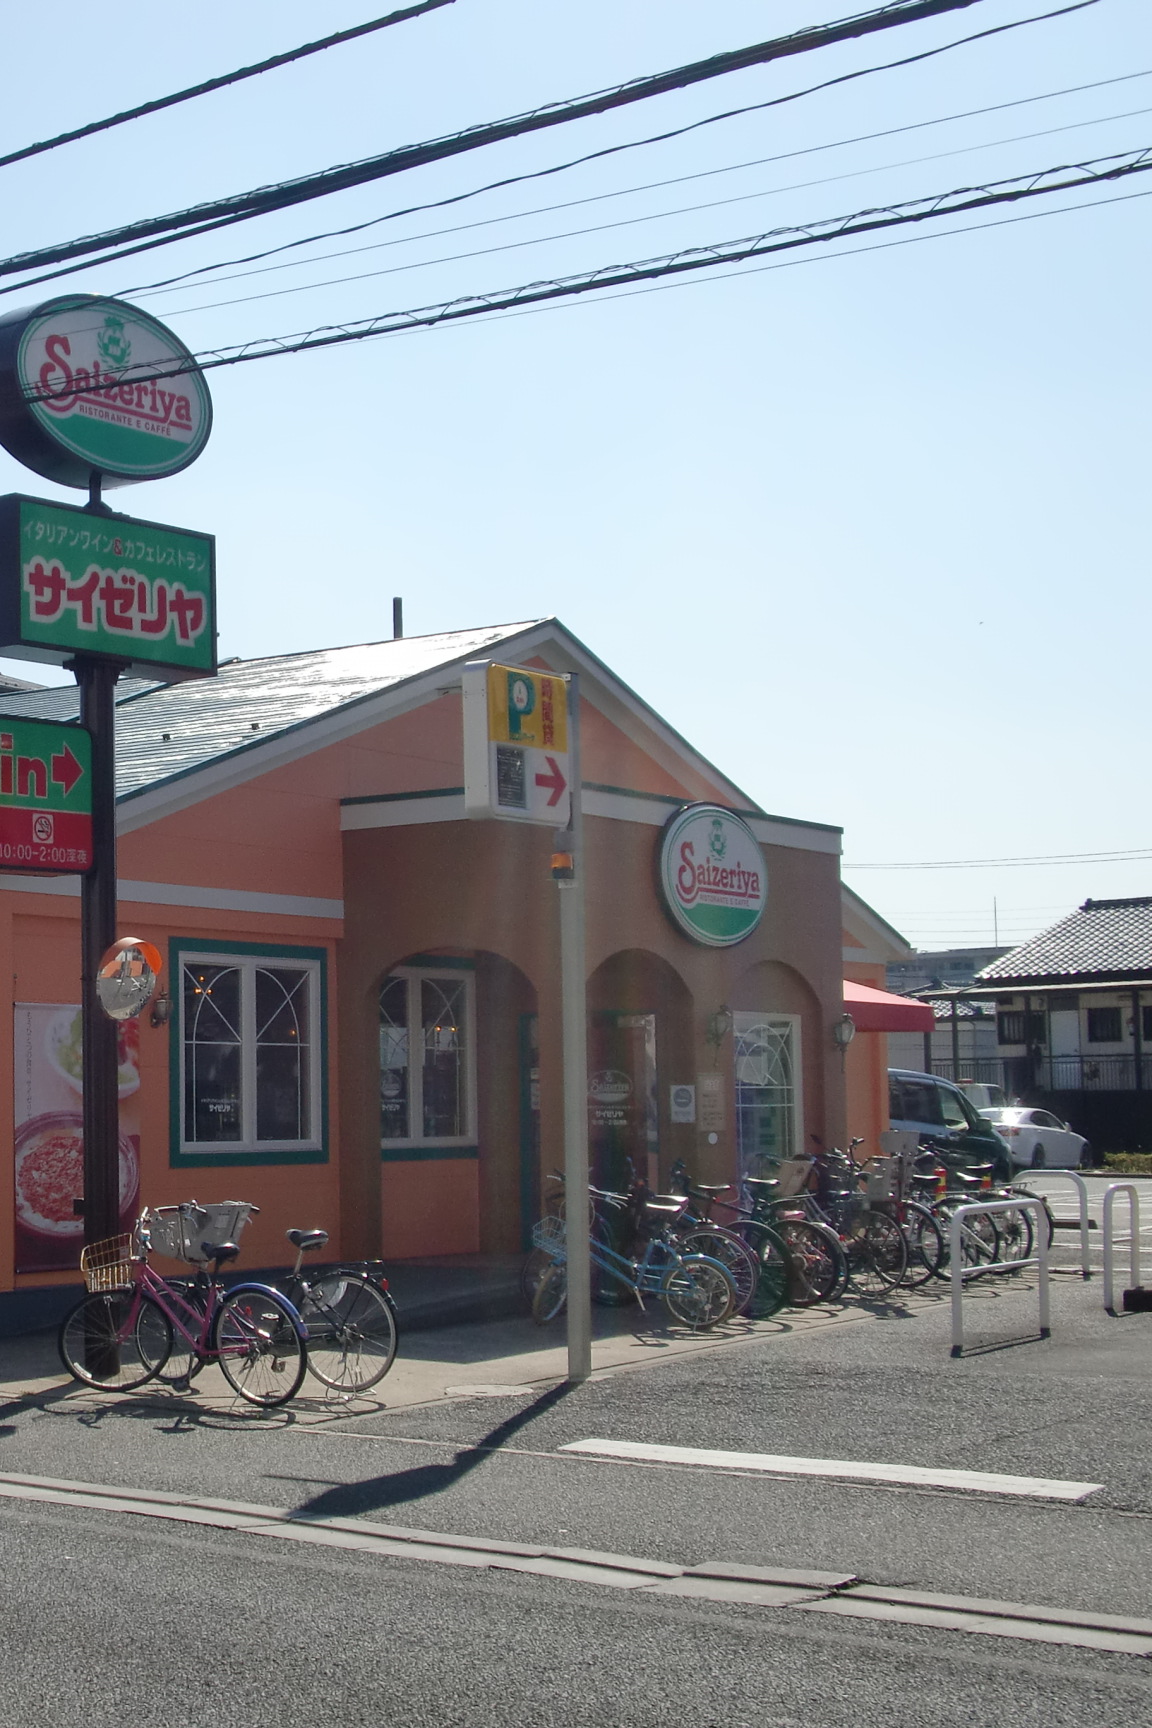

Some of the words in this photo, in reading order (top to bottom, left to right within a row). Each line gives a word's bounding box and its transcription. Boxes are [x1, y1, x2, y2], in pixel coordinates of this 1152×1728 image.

[35, 334, 193, 431] Saizeriya
[79, 404, 133, 427] RISTORANTE
[136, 419, 142, 429] E
[27, 559, 205, 643] サイゼリヤ
[0, 732, 48, 799] in
[676, 841, 760, 904] Saizeriya
